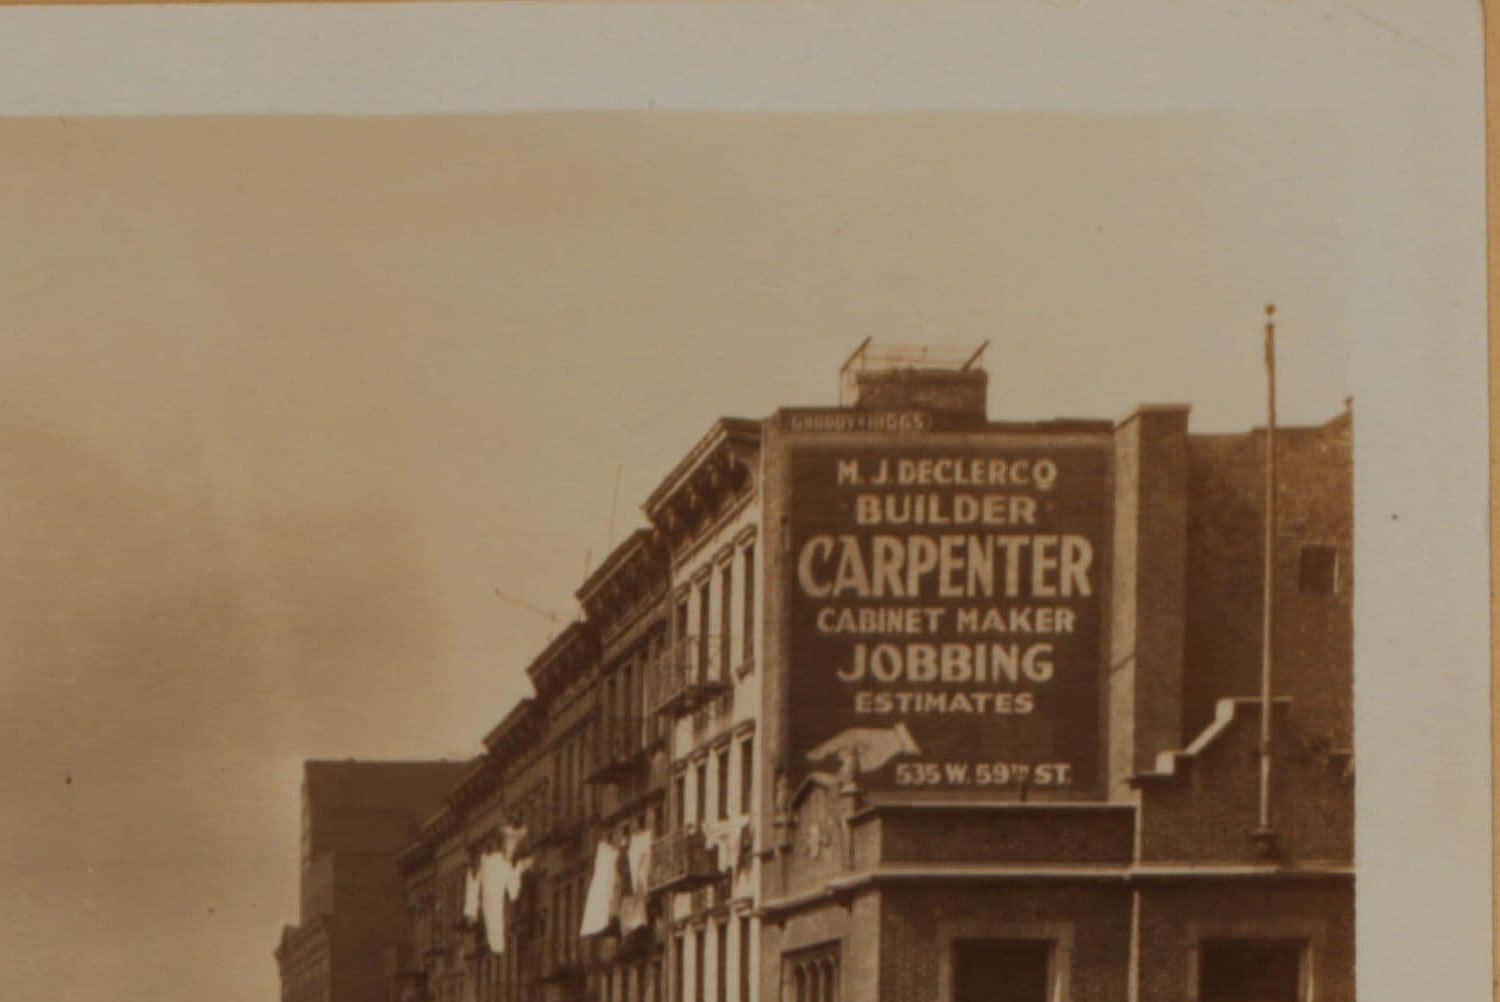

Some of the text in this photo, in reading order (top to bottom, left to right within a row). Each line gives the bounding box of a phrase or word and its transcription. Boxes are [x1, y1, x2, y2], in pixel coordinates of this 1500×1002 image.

[898, 459, 1057, 490] DECLERCQ
[856, 495, 1037, 524] BUILDER
[798, 535, 1093, 598] CARPENTER
[817, 607, 1077, 632] CABINET MAKER
[836, 643, 1054, 682] JOBBING
[854, 692, 1035, 714] ESTIMATES
[895, 764, 942, 785] 535
